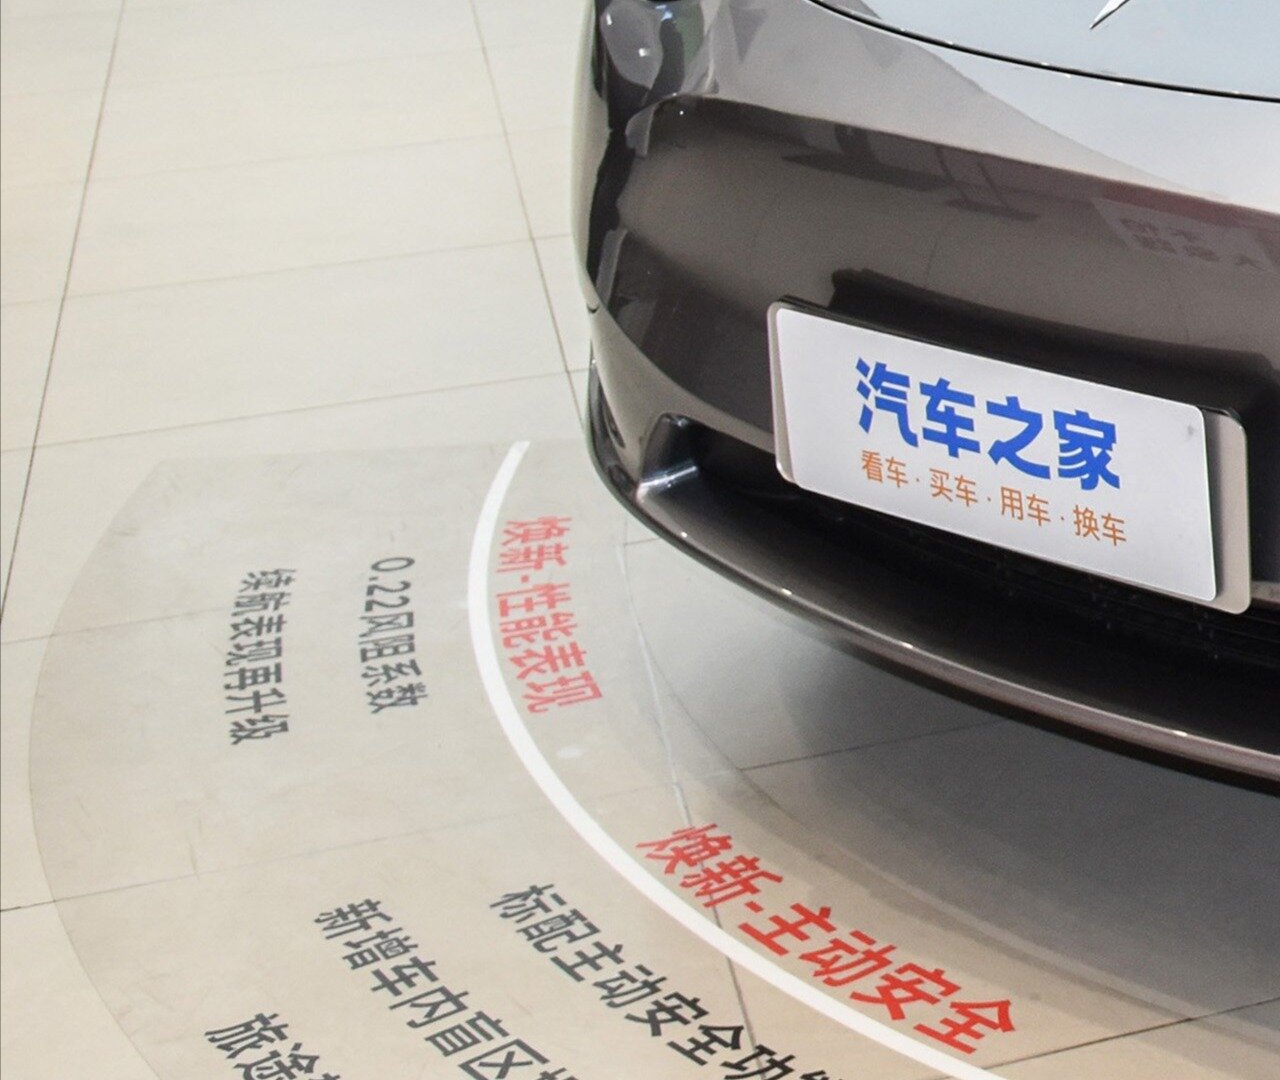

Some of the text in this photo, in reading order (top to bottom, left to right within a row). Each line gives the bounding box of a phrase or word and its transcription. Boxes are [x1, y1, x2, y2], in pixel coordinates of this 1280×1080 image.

[855, 358, 1121, 491] 汽车之家
[224, 568, 296, 745] 续航表现再升级
[358, 556, 428, 714] 0.22风阻系数
[204, 1013, 342, 1080] 旅途
[313, 897, 578, 1080] 新增车内盲区
[490, 882, 845, 1080] 标配主动安全功
